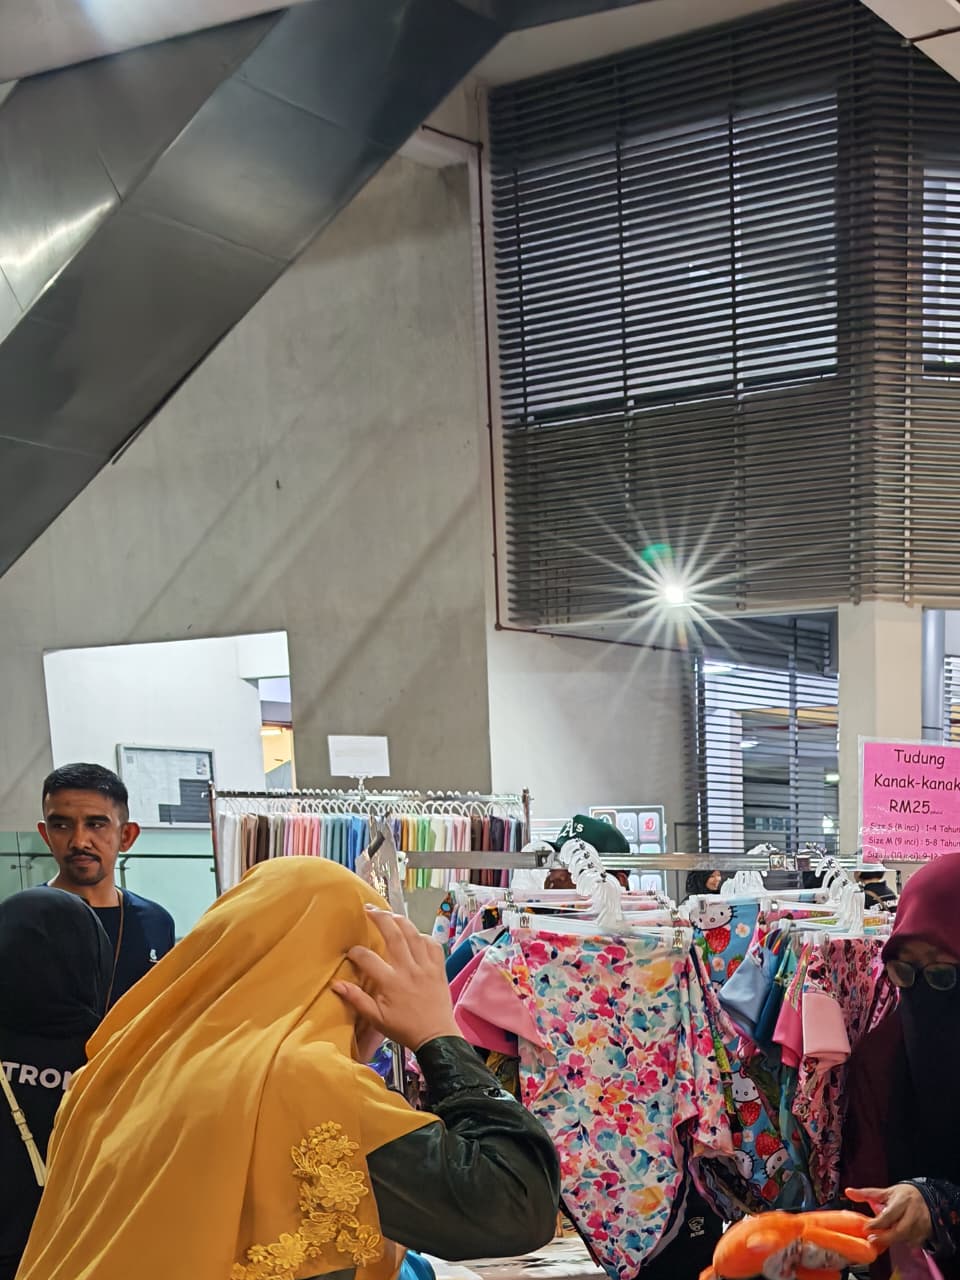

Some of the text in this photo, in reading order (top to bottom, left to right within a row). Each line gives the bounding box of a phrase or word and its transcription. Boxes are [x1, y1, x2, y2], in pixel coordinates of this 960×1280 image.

[894, 749, 945, 769] Tudung
[874, 773, 960, 791] Kanak-kanak
[889, 799, 931, 815] RM25
[940, 825, 960, 833] Tahun
[868, 836, 884, 845] Size
[925, 839, 938, 847] 5-8
[940, 839, 960, 847] Tahun
